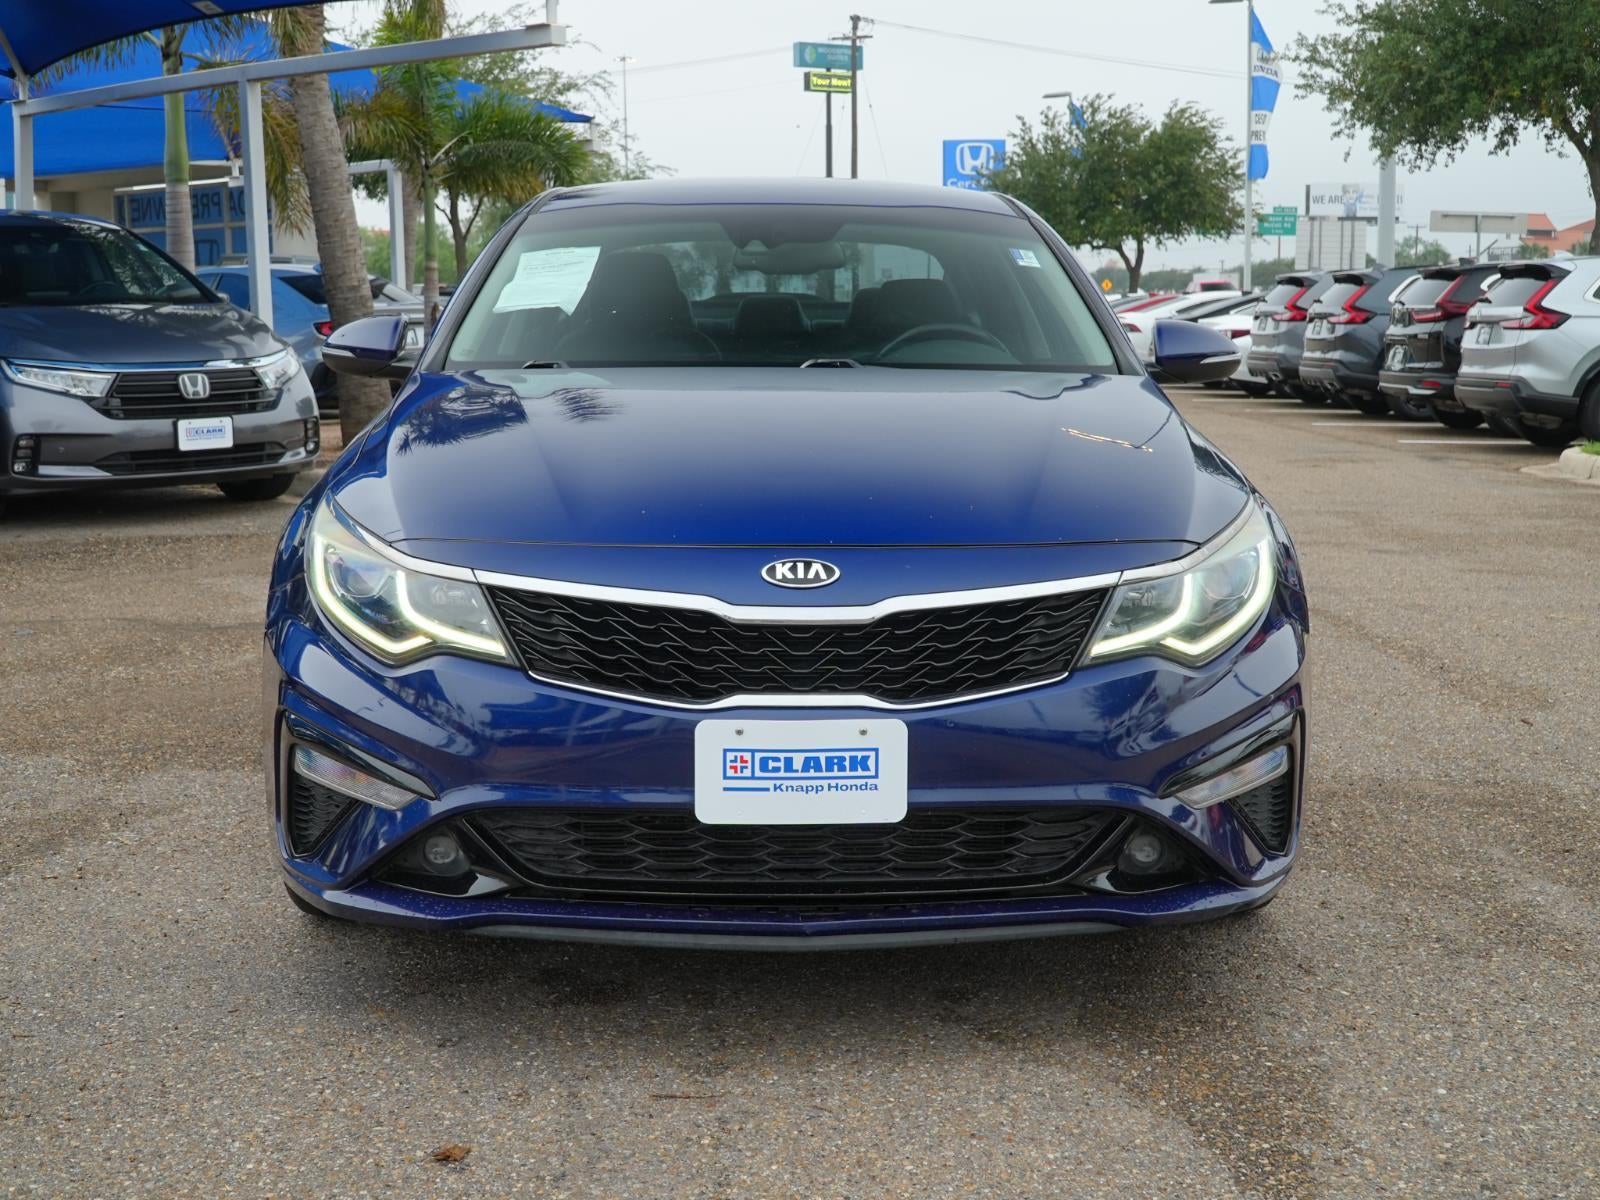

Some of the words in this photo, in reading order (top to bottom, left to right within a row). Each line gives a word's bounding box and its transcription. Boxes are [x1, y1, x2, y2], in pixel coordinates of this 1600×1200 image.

[1312, 195, 1326, 204] WE
[1328, 195, 1344, 204] ARE
[775, 562, 828, 579] KIA
[759, 755, 871, 773] CLARK
[773, 783, 824, 794] Knapp
[828, 782, 878, 792] Honda
